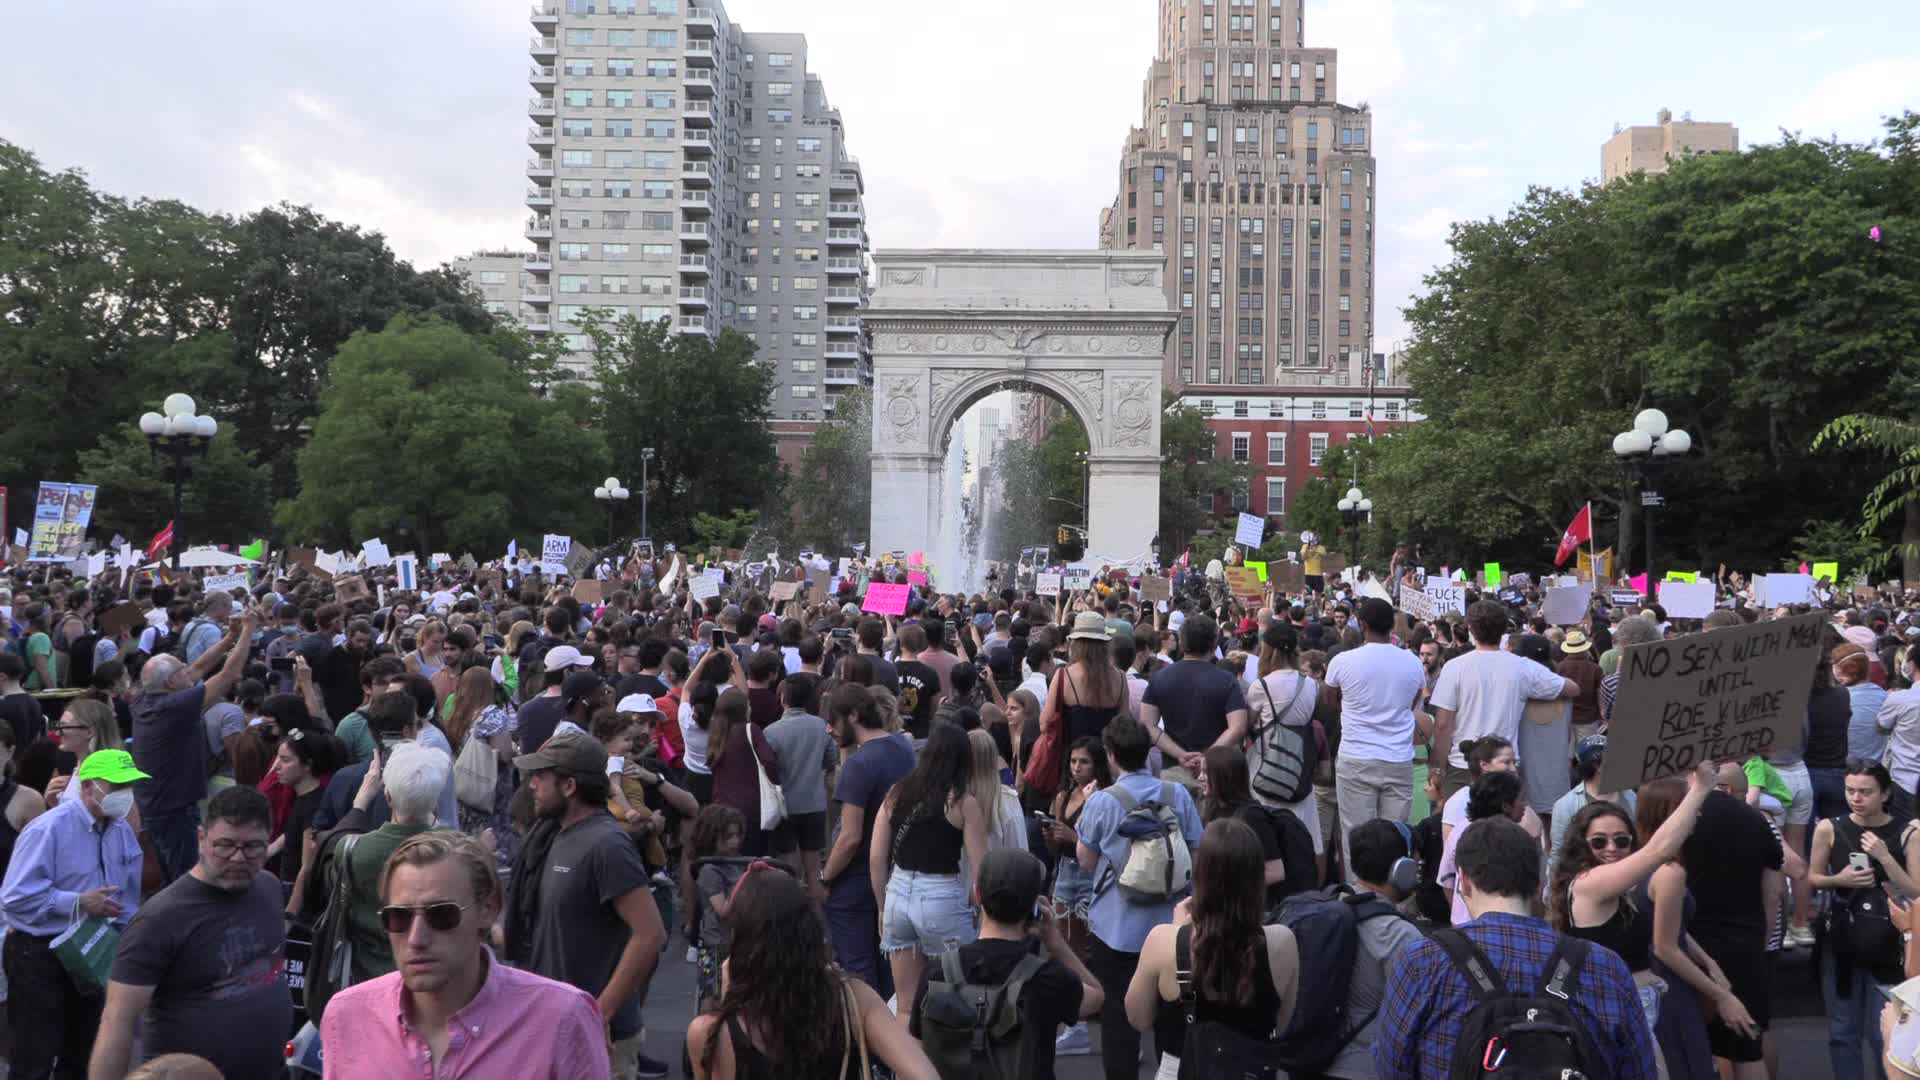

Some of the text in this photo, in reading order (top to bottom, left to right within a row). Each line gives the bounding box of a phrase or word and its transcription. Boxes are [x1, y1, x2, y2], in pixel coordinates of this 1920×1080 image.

[545, 540, 567, 552] ARM
[1427, 588, 1461, 600] FUCK
[1434, 602, 1457, 613] THIS
[1630, 616, 1823, 680] NO SEX WITH MEN
[1699, 666, 1753, 697] UNTIL
[1657, 700, 1706, 739] ROE
[1734, 689, 1785, 722] WADE
[1703, 721, 1726, 738] IS
[1641, 727, 1775, 780] PROTECTED
